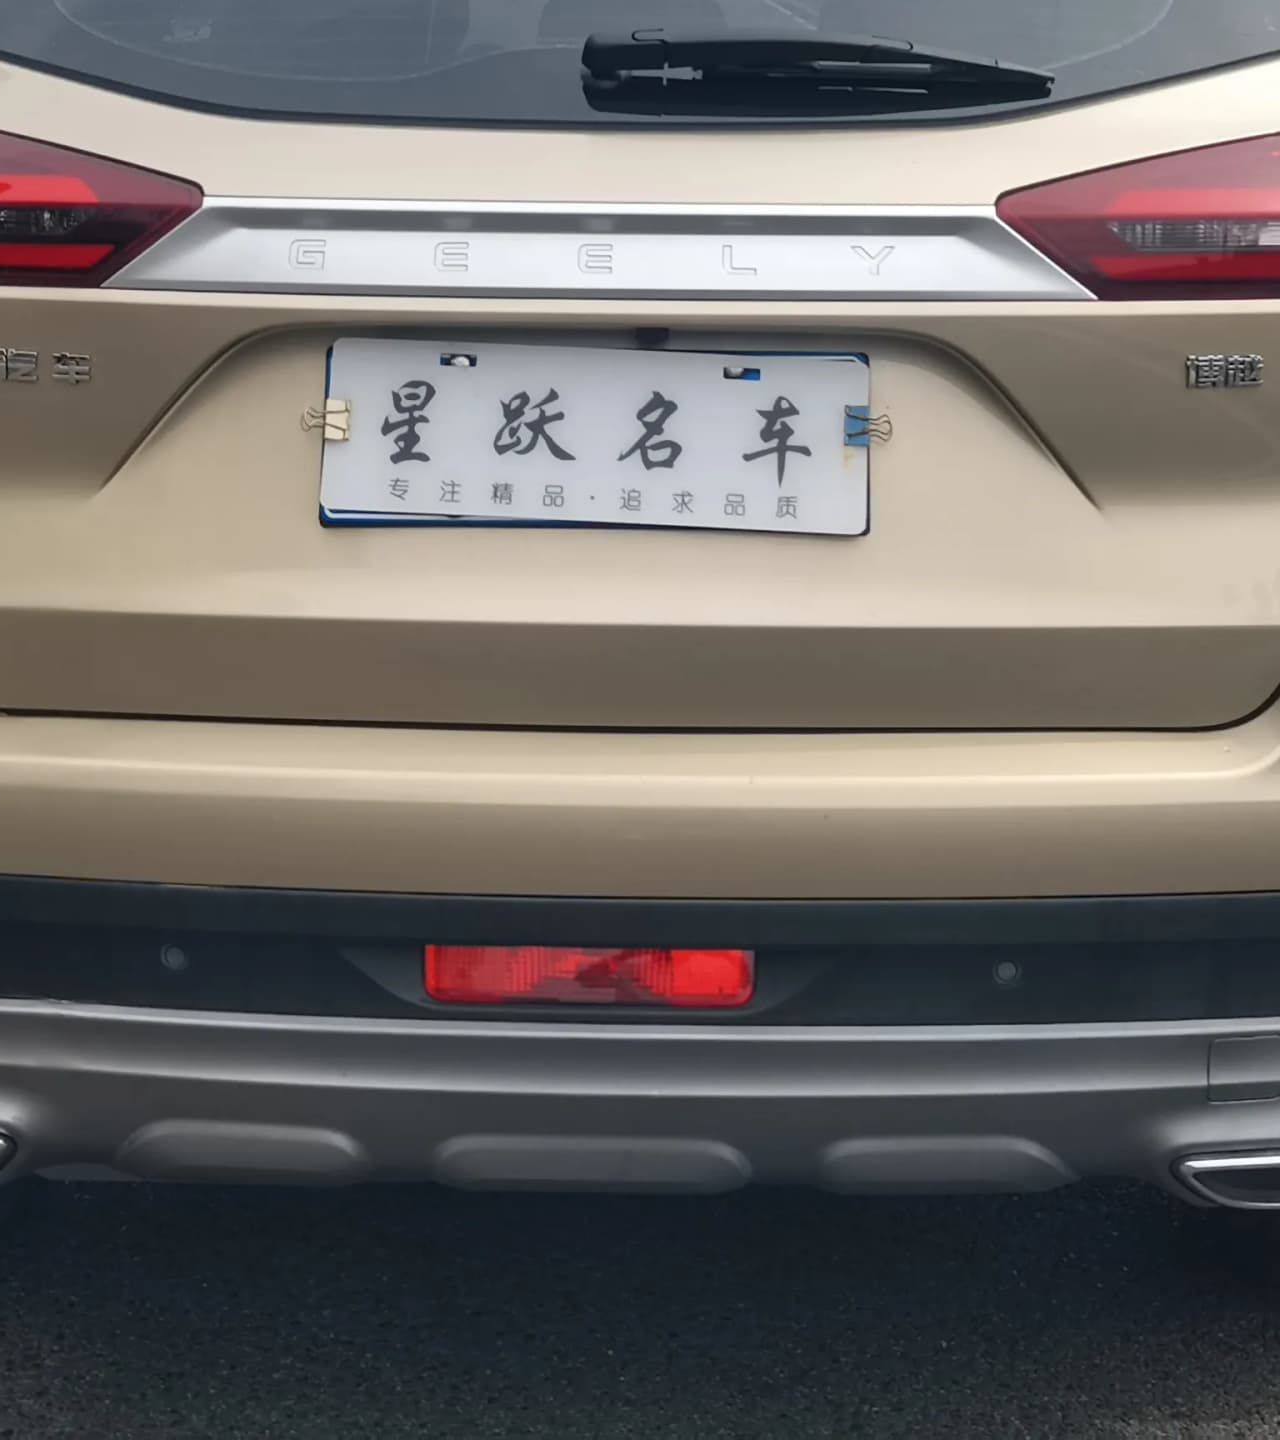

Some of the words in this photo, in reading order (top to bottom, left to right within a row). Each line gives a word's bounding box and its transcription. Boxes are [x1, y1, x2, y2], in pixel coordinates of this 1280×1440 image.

[287, 238, 896, 276] GEELY
[1184, 354, 1265, 388] 博越
[380, 379, 812, 488] 星跃名车
